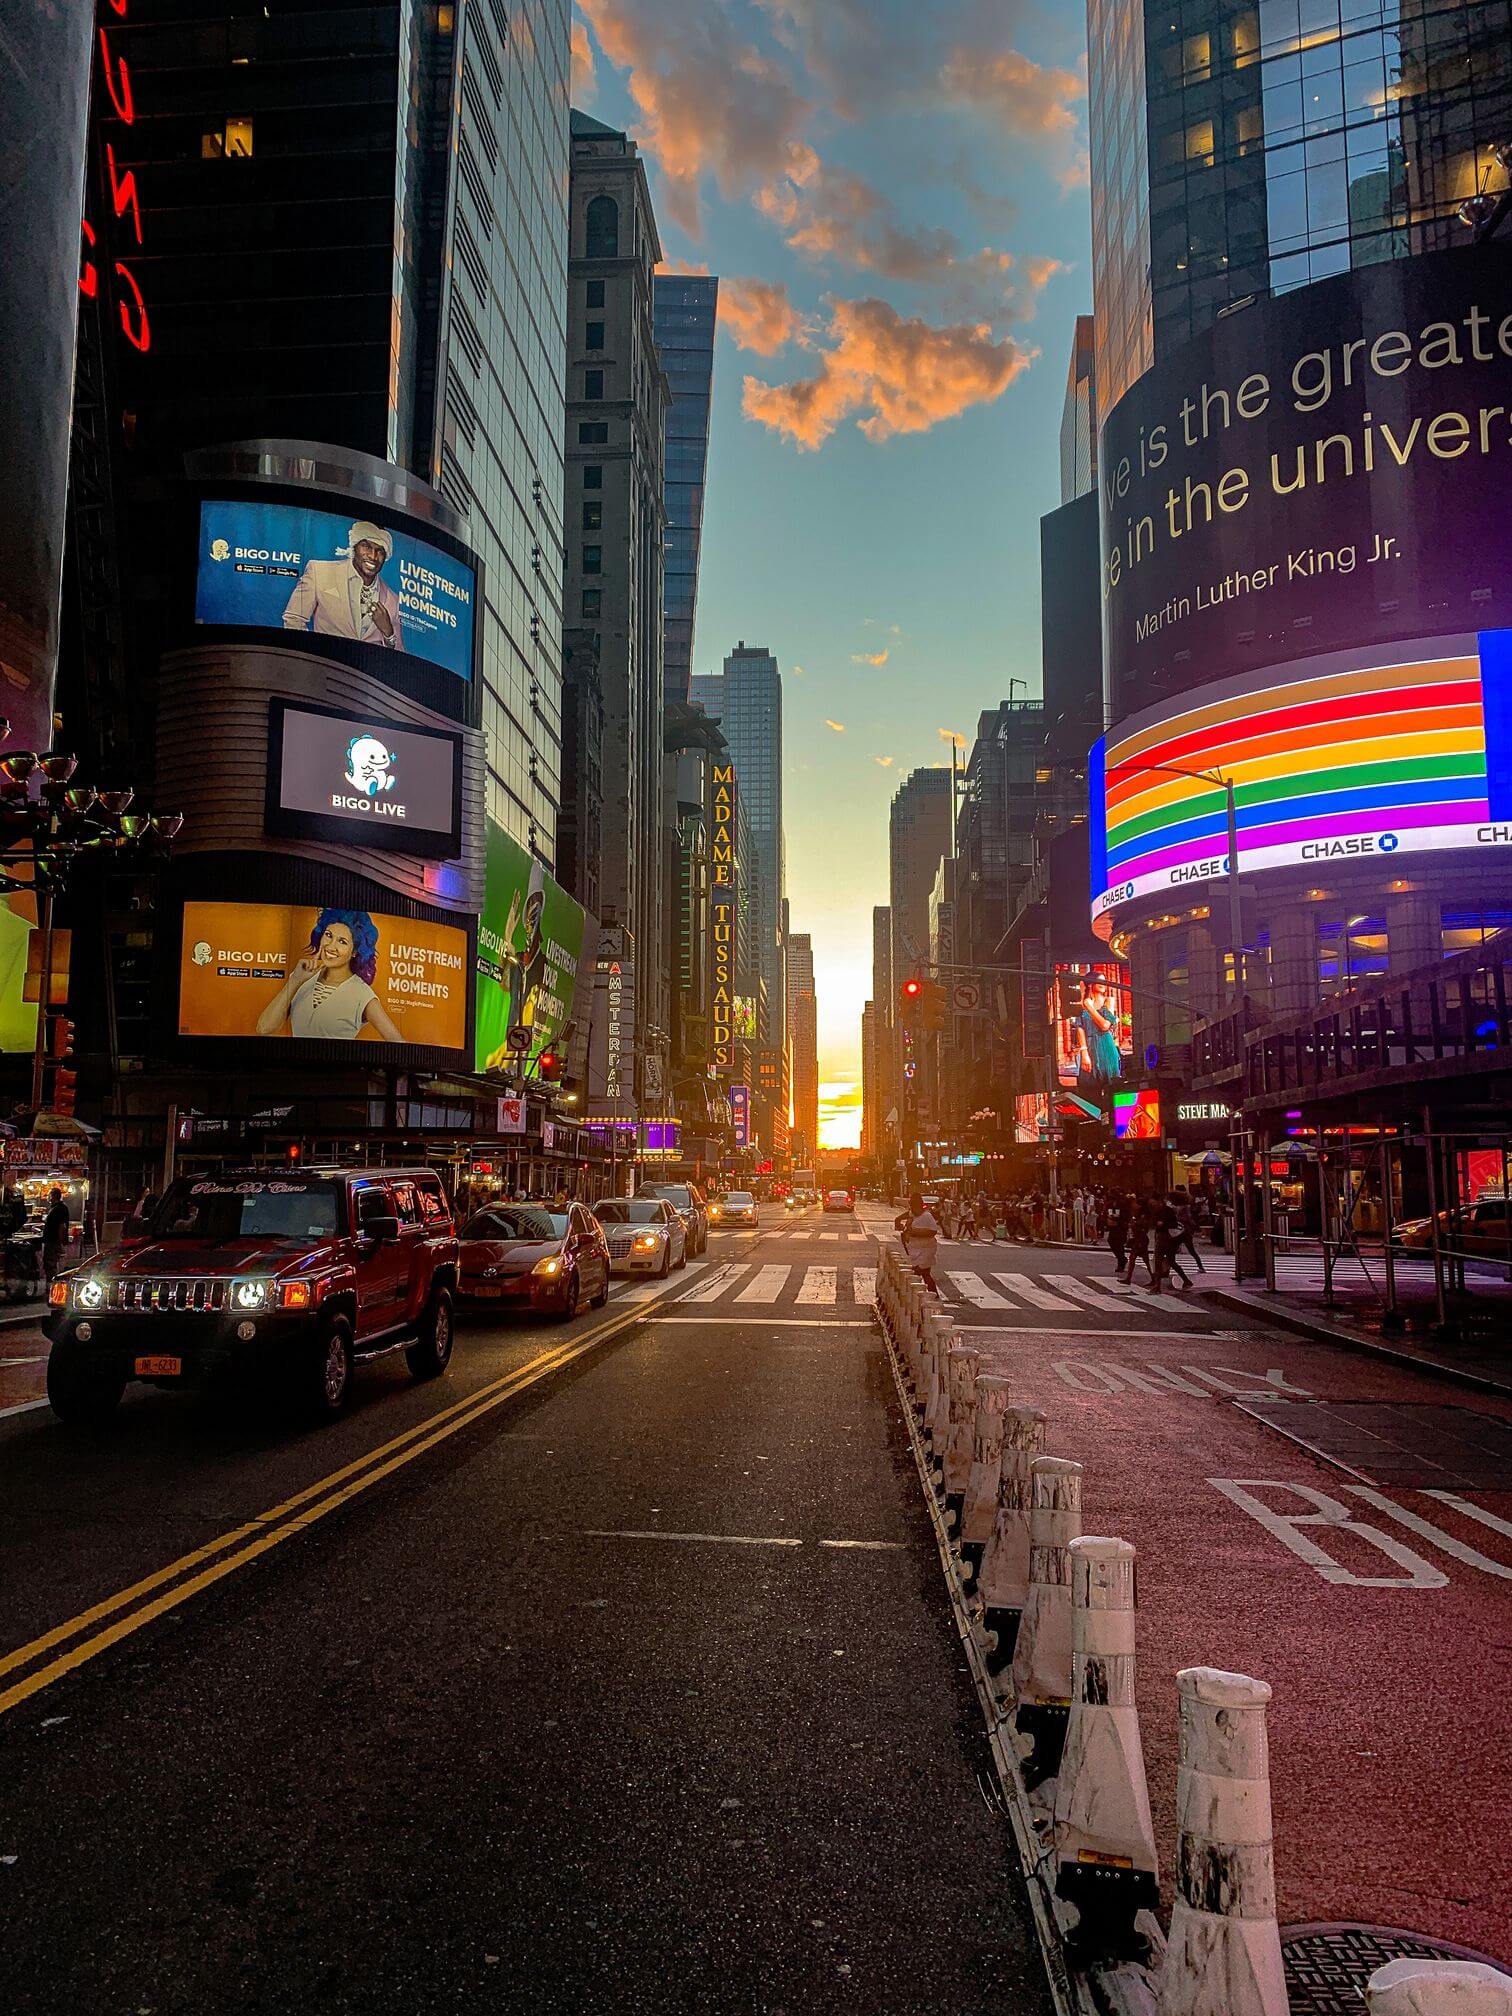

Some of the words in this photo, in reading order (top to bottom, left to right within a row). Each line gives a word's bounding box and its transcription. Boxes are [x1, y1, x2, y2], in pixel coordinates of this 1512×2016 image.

[1139, 422, 1168, 478] is
[1180, 373, 1270, 448] the
[1127, 513, 1154, 569] in
[1165, 465, 1249, 539] the
[1270, 406, 1512, 494] univer
[235, 547, 269, 560] BIGO
[272, 551, 301, 564] LIVE
[400, 560, 469, 604] LIVESTREAM
[400, 576, 433, 601] YOUR
[1135, 596, 1189, 643] Martin
[1197, 565, 1279, 611] Luther
[1288, 544, 1356, 581] King
[1367, 534, 1401, 562] Jr.
[399, 591, 457, 628] MOMENTS
[332, 795, 370, 811] BIGO
[374, 801, 406, 818] LIVE
[712, 765, 733, 882] MADAME
[1477, 826, 1512, 843] CH
[1301, 837, 1374, 860] CHASE
[1170, 860, 1220, 884] CHASE
[1102, 886, 1125, 908] CHASE
[479, 926, 496, 949] BIGO
[218, 950, 254, 962] BIGO
[256, 953, 287, 964] LIVE
[390, 944, 462, 970] LIVESTREAM
[390, 961, 424, 978] YOUR
[547, 938, 577, 978] LIVESTREAM
[388, 977, 449, 999] MOMENTS
[543, 962, 558, 991] YOUR
[713, 905, 730, 1065] TUSSAUD'S
[537, 987, 565, 1021] MOMENTS
[606, 961, 622, 1097] AMSTERDAM
[1179, 1104, 1208, 1119] STEVE
[1050, 1360, 1314, 1401] ONLY
